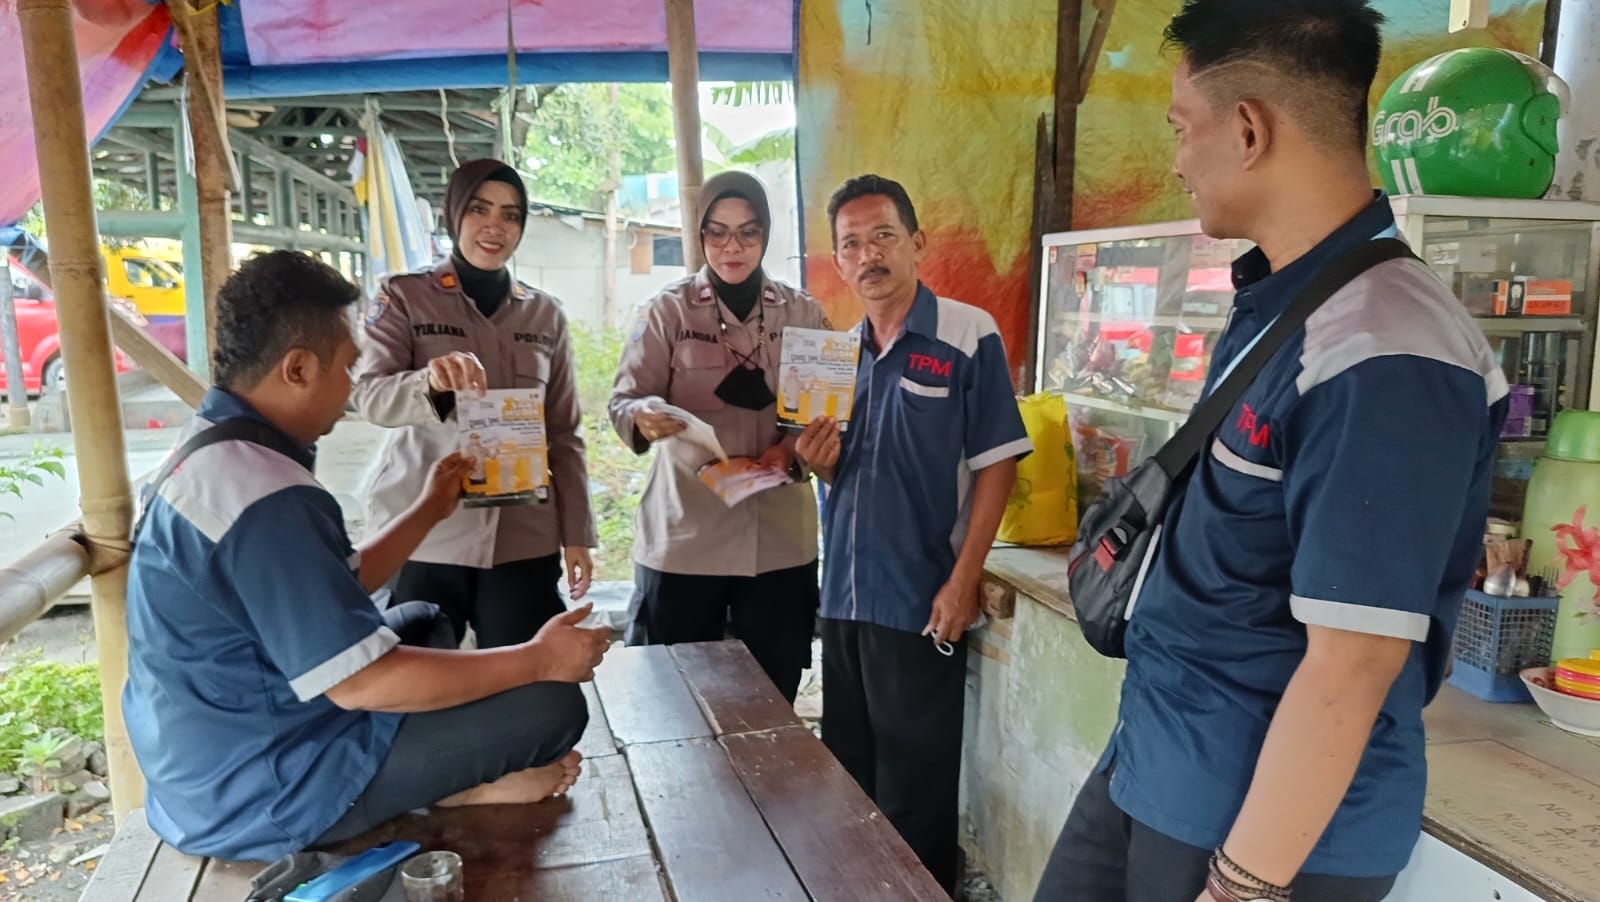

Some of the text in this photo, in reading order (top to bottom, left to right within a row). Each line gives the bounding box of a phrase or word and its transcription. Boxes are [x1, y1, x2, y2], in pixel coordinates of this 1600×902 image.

[1372, 96, 1457, 146] Grab
[908, 352, 952, 377] TPM
[1235, 402, 1270, 449] TPM
